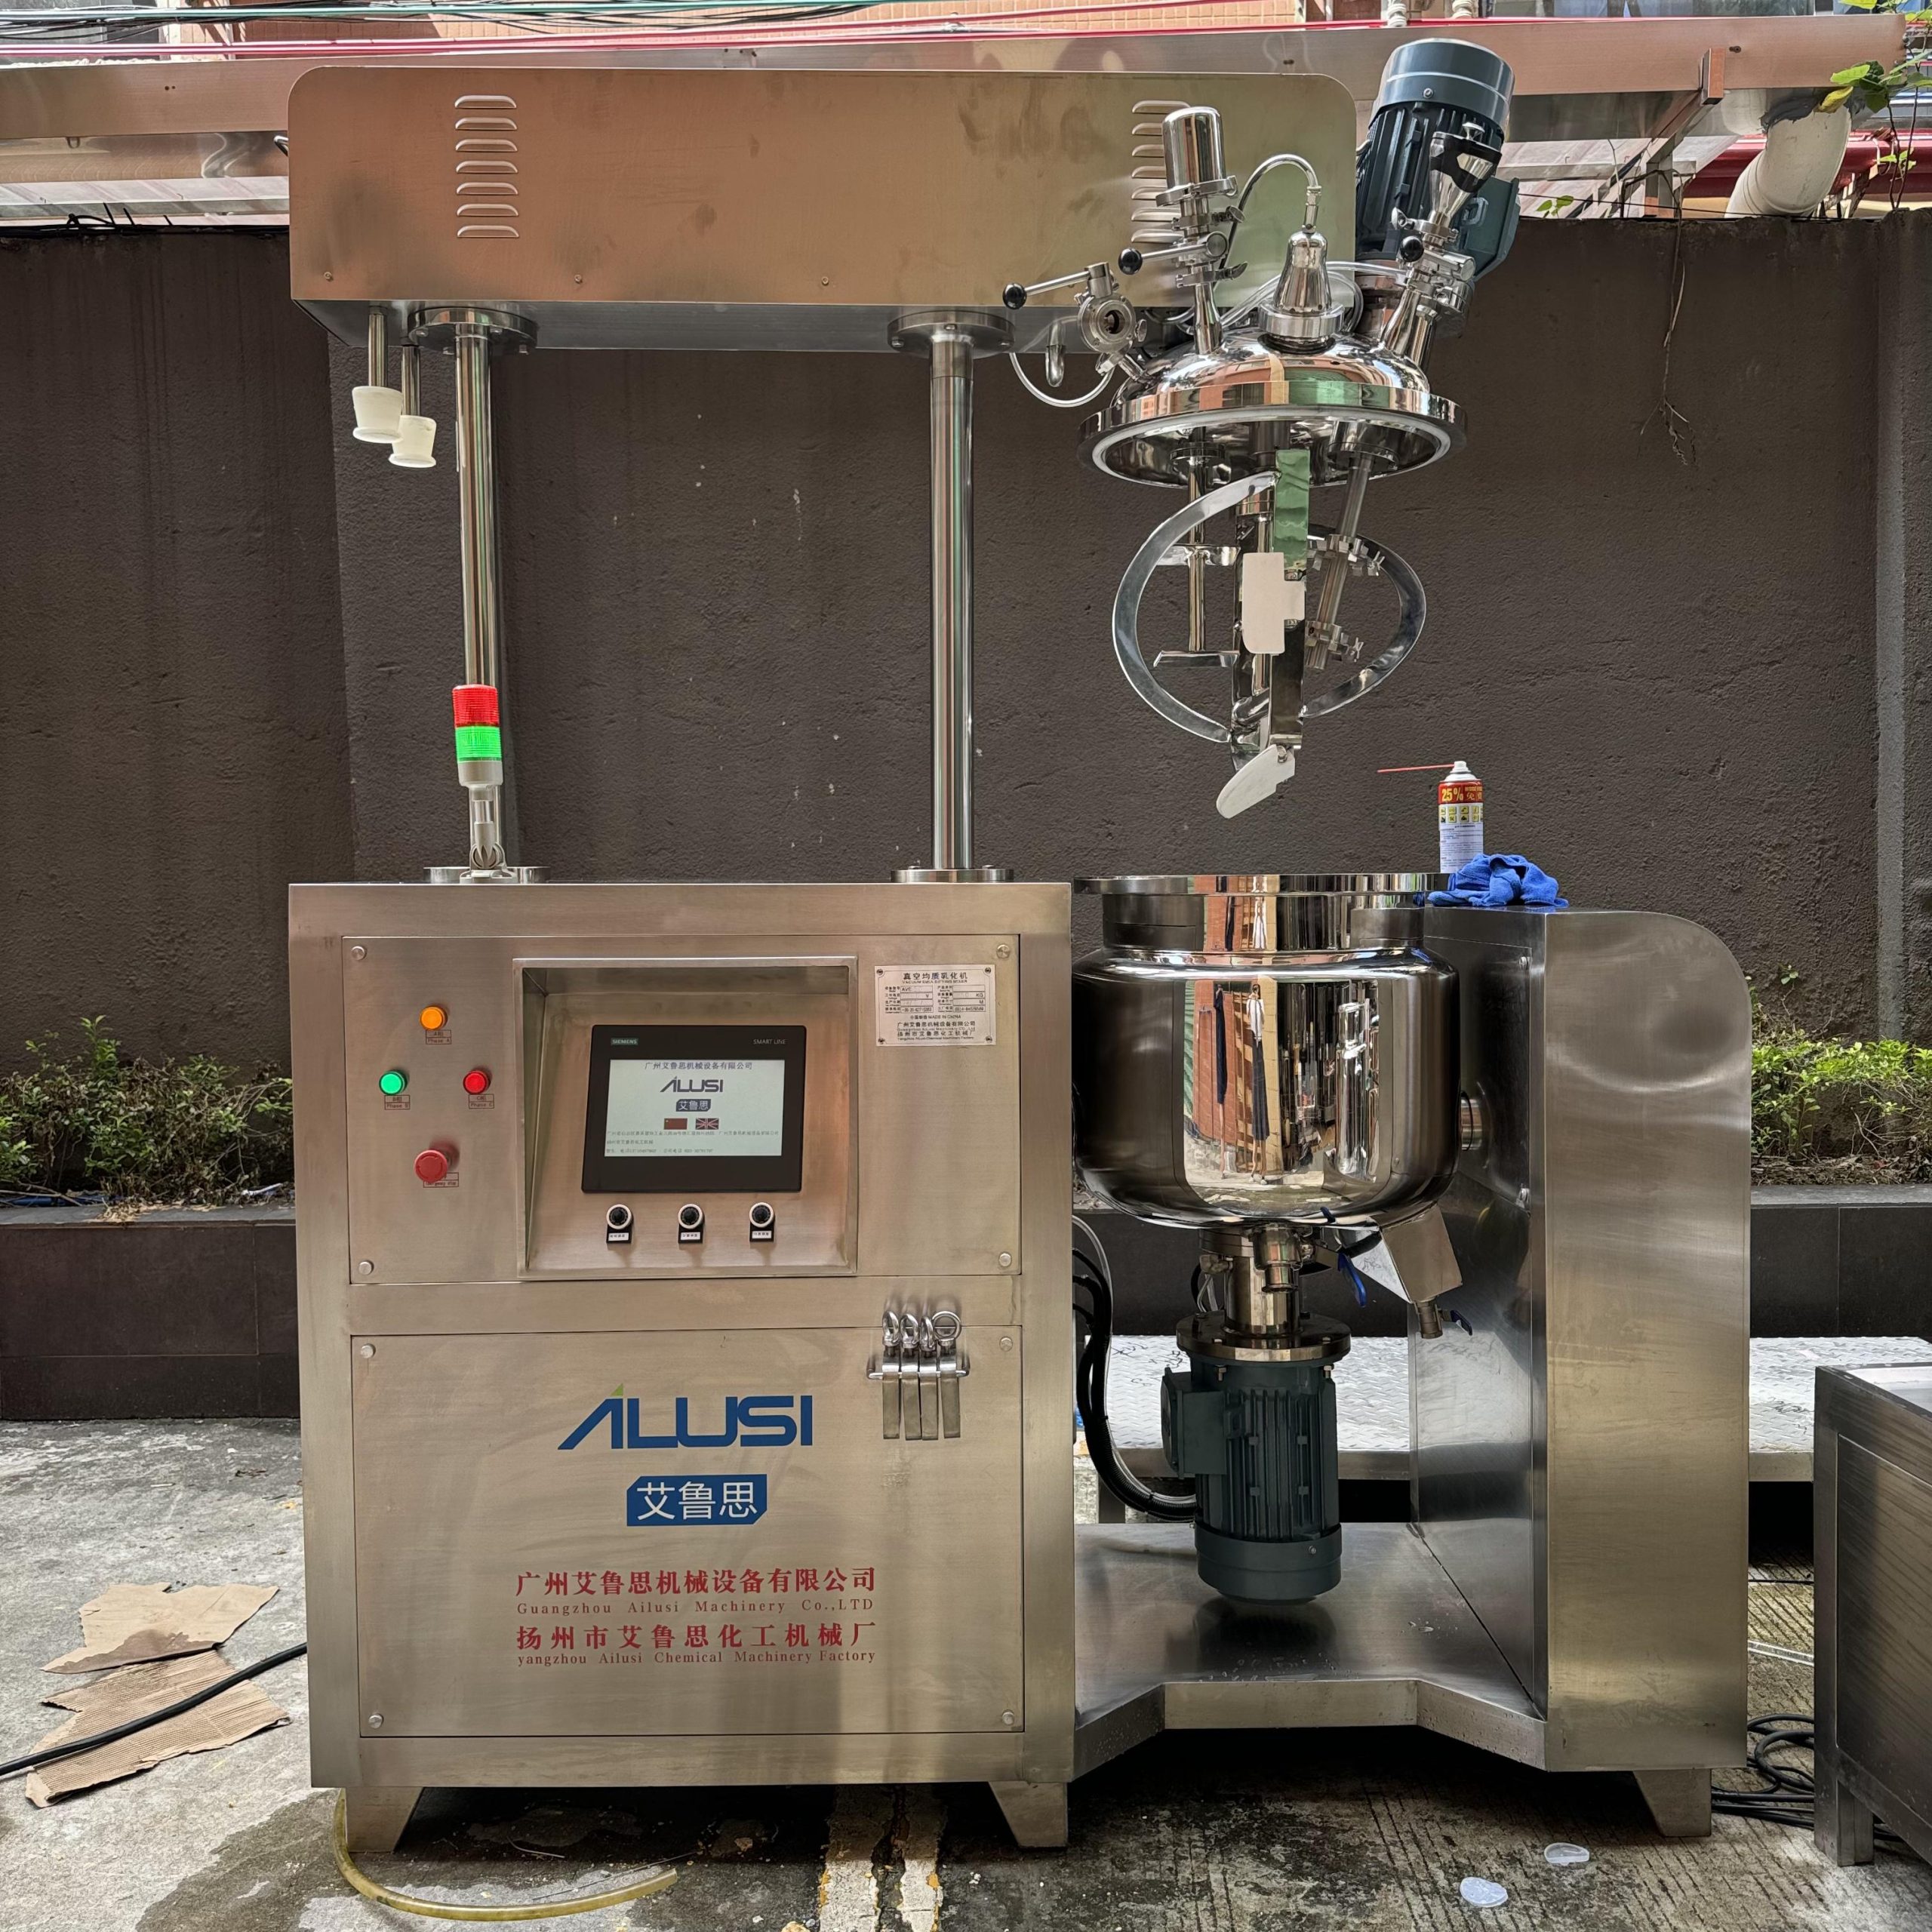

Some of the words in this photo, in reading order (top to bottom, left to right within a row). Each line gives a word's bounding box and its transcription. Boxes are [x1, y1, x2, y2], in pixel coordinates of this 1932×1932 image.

[645, 1062, 752, 1070] 广州艾鲁思机械设备有限公司
[678, 1100, 709, 1110] 艾鲁思
[637, 1481, 757, 1521] 艾鲁思
[516, 1567, 875, 1597] 广州艾鲁思机械设备有限公司
[517, 1603, 611, 1616] Guangzhou
[627, 1601, 678, 1614] Ailusi
[695, 1601, 785, 1614] Machinery
[516, 1622, 875, 1651] 扬州市艾鲁思化工机械厂
[518, 1654, 586, 1666] yangzhou
[598, 1652, 642, 1664] Ailusi
[654, 1651, 722, 1663] Chemical
[735, 1651, 812, 1664] Machinery
[820, 1651, 875, 1663] Factory
